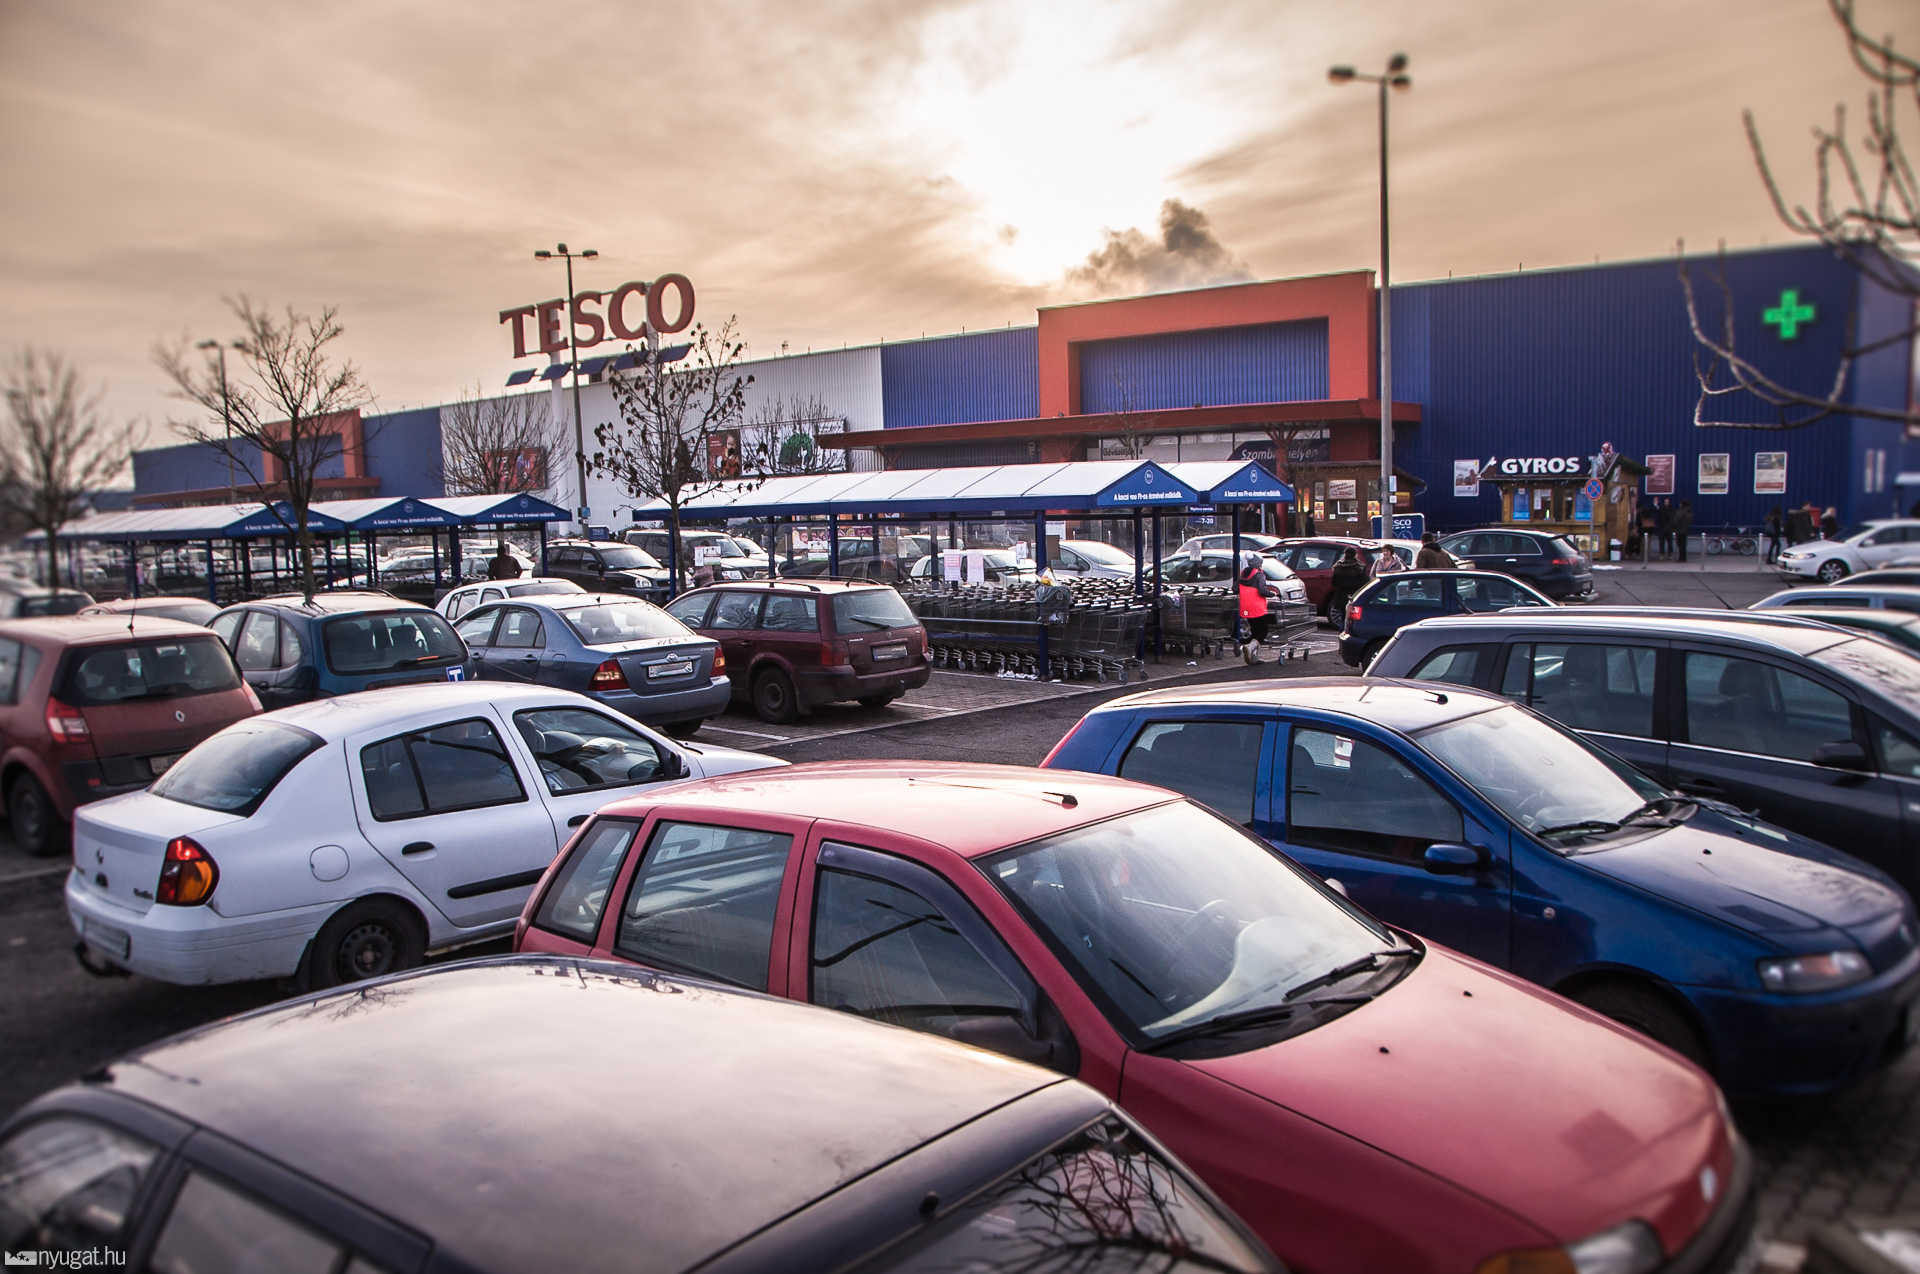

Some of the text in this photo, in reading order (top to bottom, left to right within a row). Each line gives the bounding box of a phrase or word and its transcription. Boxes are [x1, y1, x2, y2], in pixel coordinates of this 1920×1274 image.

[499, 273, 695, 359] TESCO
[1501, 457, 1580, 473] GYROS
[449, 669, 461, 681] T
